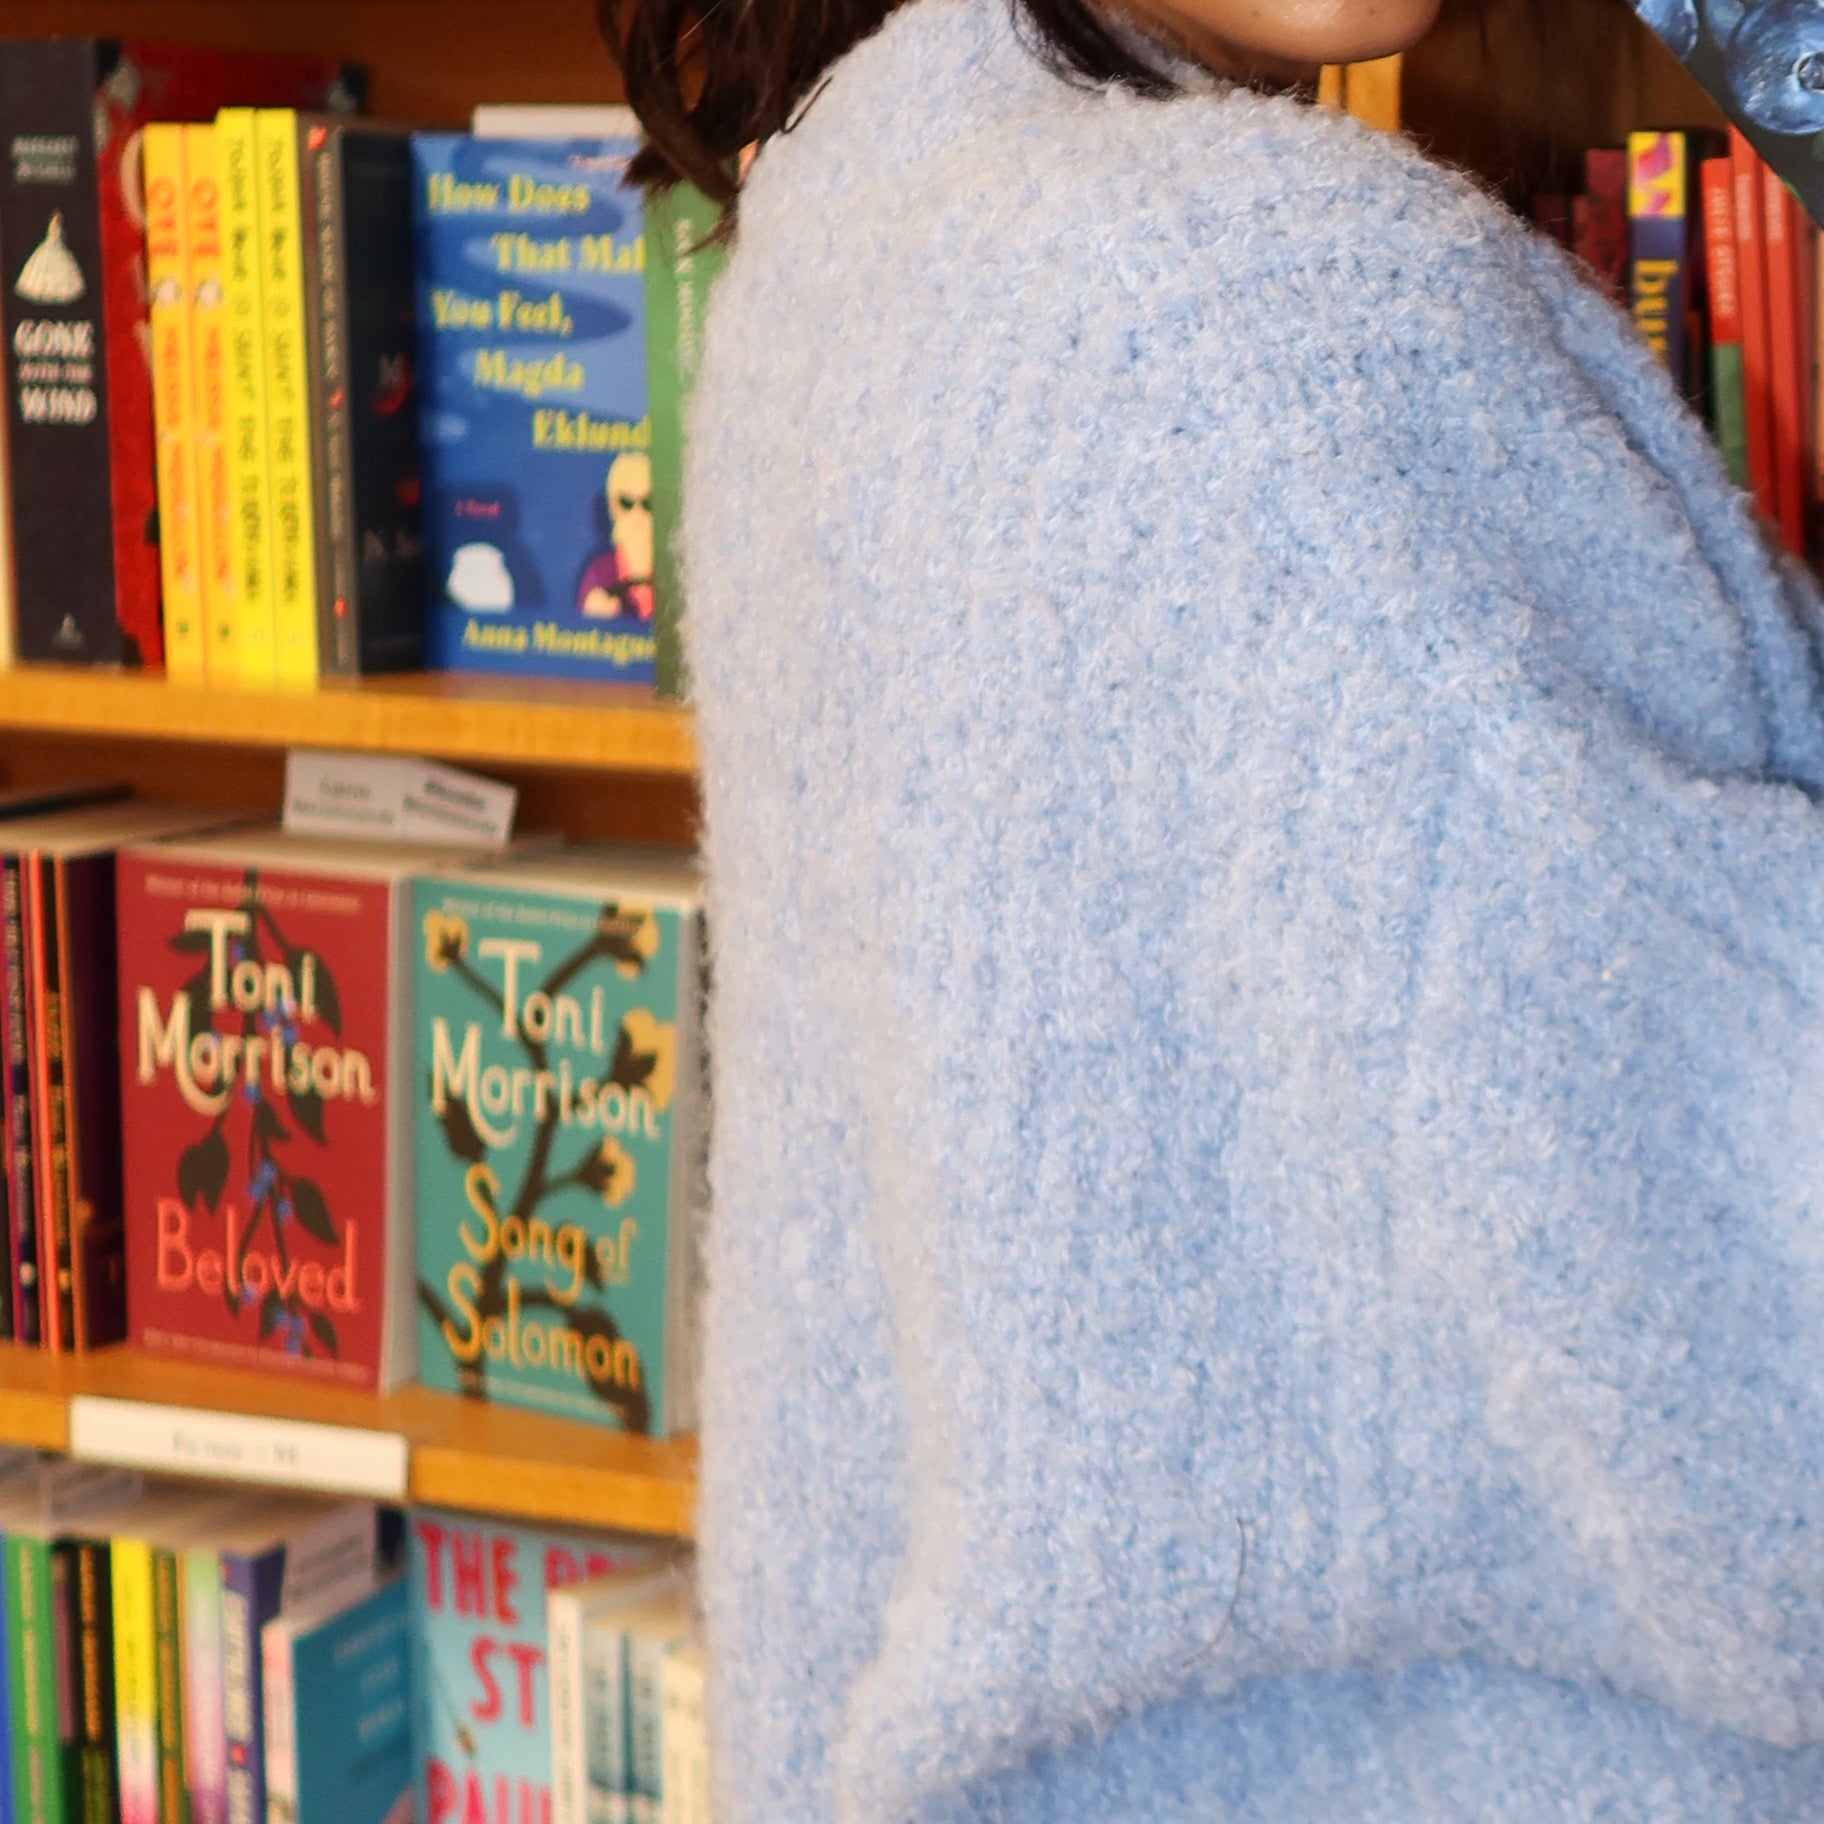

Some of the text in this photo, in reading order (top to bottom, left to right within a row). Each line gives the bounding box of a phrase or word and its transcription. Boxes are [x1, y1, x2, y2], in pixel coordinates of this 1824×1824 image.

[427, 172, 592, 214] How Does
[432, 288, 493, 329] You
[473, 350, 584, 398] Magda
[183, 907, 319, 1024] Toni
[477, 937, 608, 1057] Toni
[135, 984, 379, 1118] Morrison
[430, 1015, 661, 1151] Morrison
[155, 1195, 362, 1318] Beloved
[458, 1162, 639, 1308] Song of
[439, 1261, 642, 1393] Solomon
[414, 1520, 521, 1627] THE
